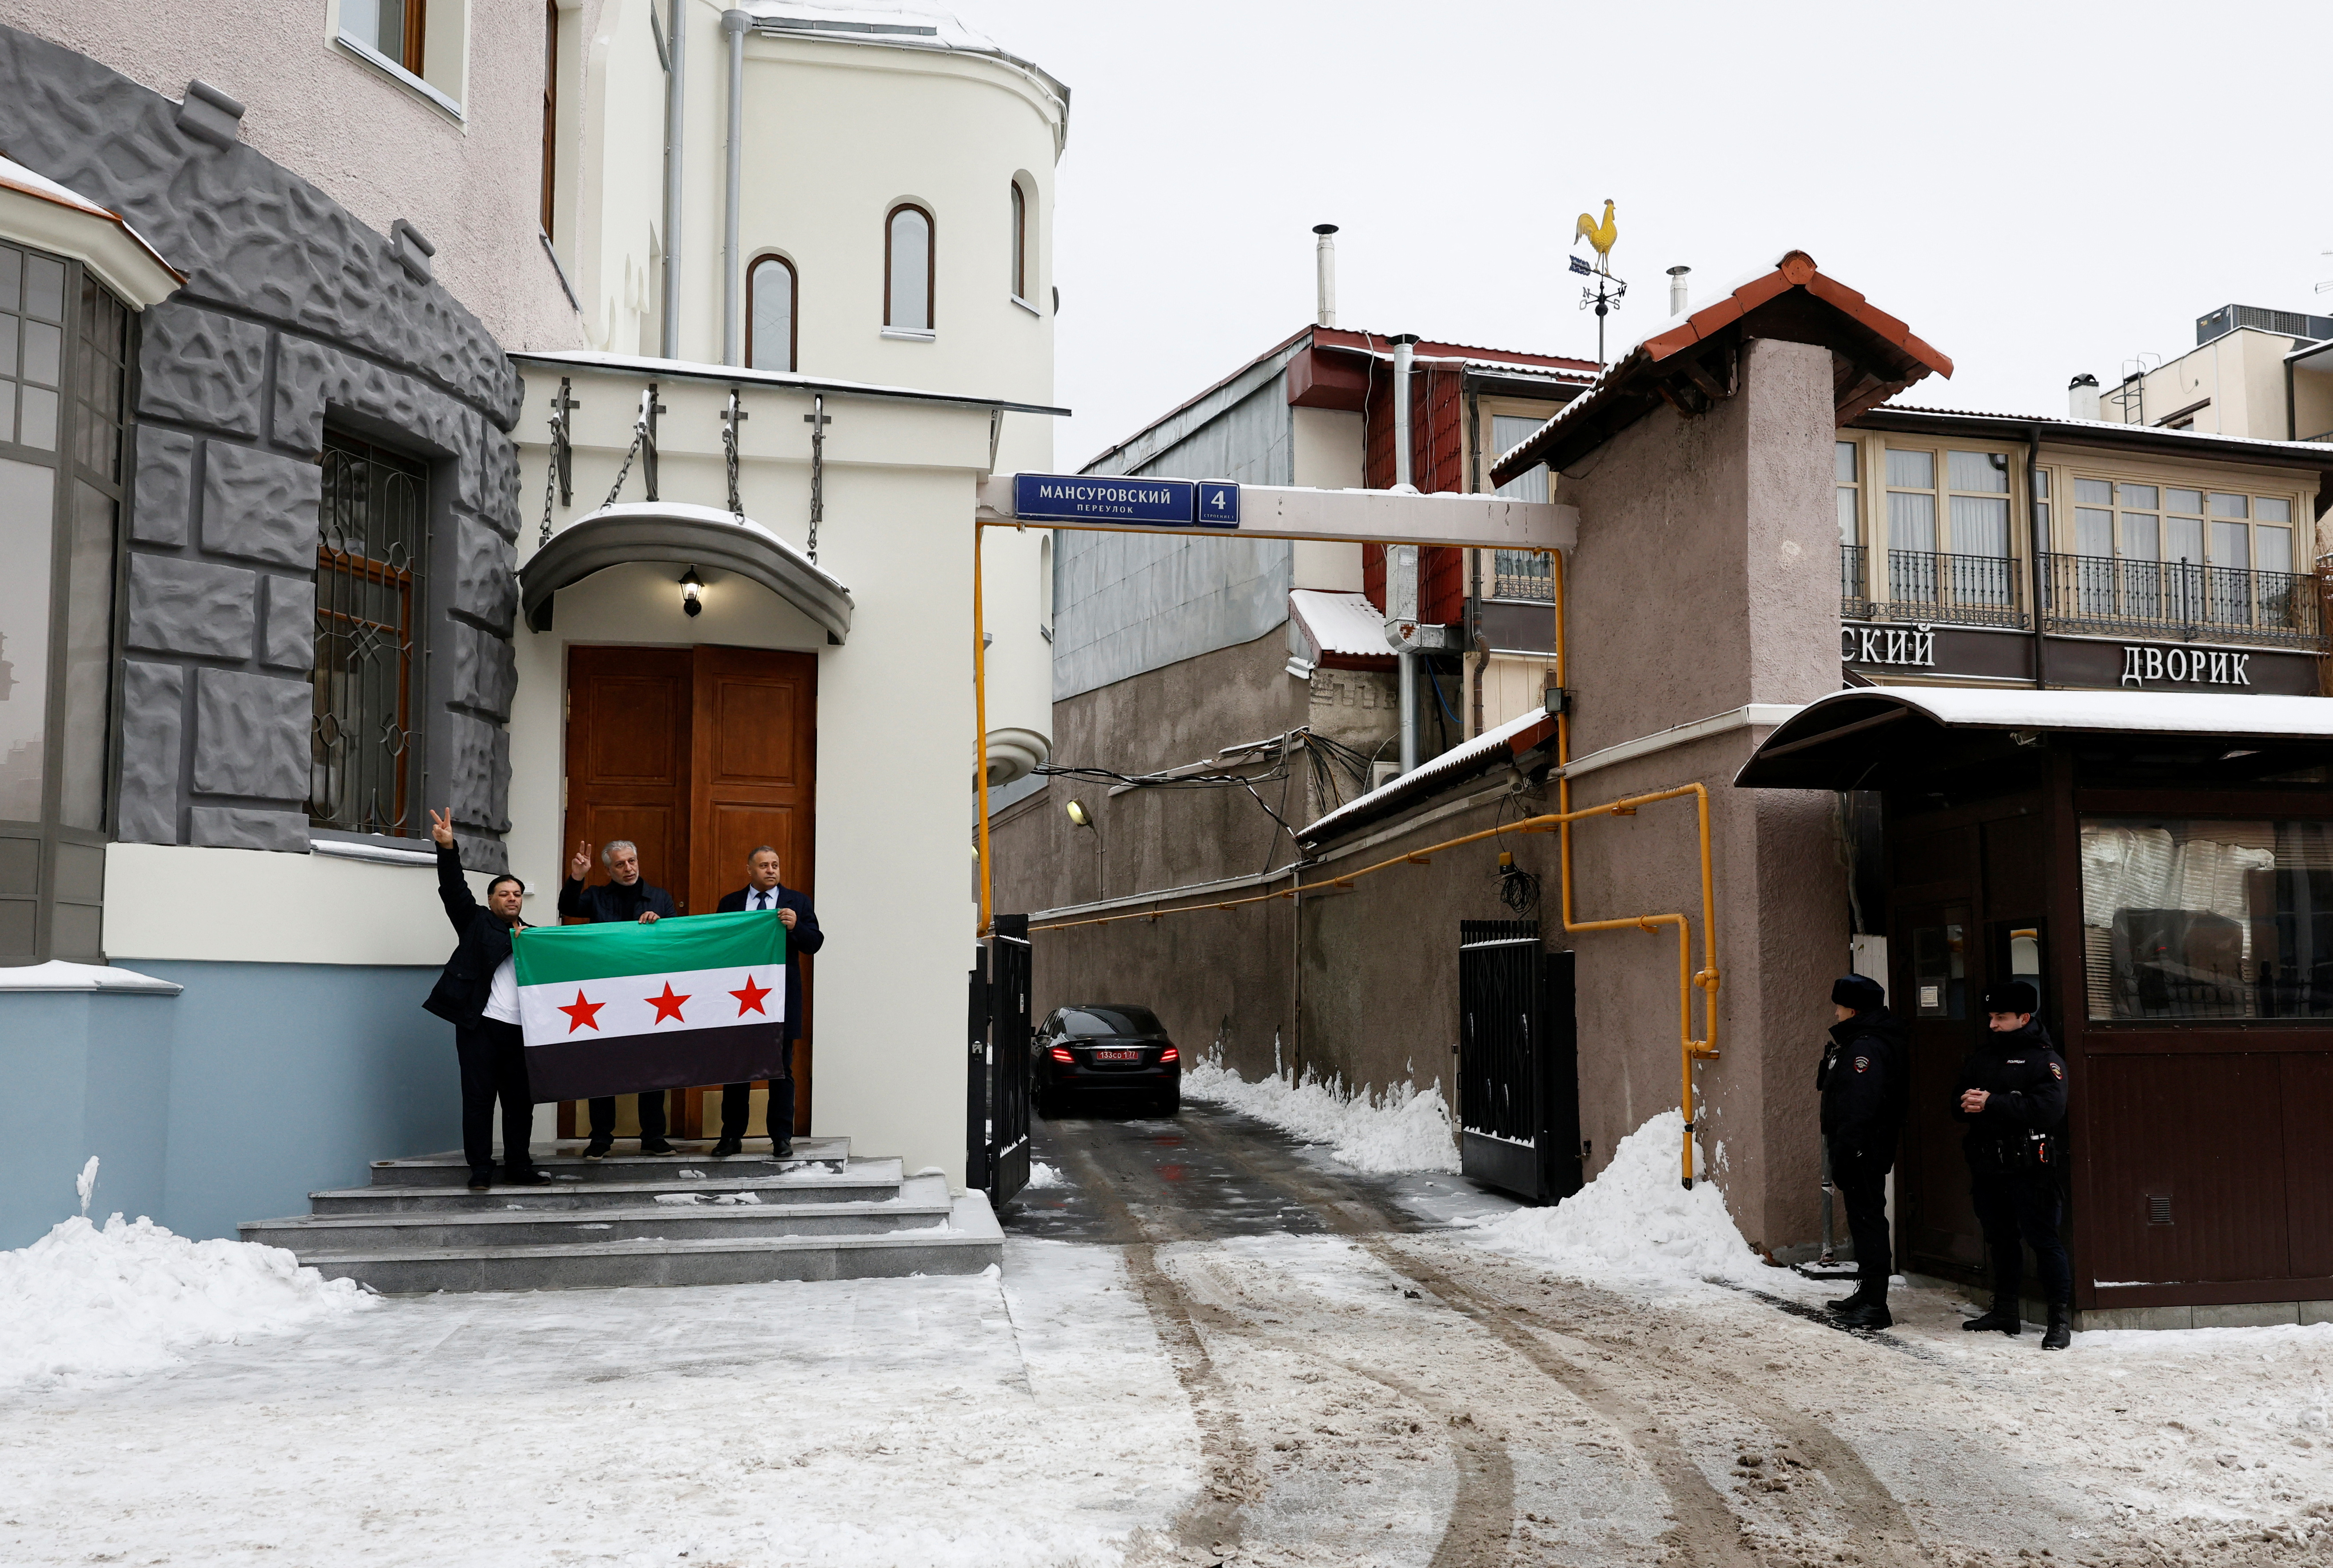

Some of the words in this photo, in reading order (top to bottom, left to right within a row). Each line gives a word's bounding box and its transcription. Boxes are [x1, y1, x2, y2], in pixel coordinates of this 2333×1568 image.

[1039, 485, 1170, 504] МАНСУРОВСКИЙ
[1210, 490, 1226, 510] 4
[1077, 504, 1134, 513] ПЕРЕУЛОК
[1842, 622, 1936, 666] СКИЙ
[2122, 646, 2251, 687] ДВОРИК
